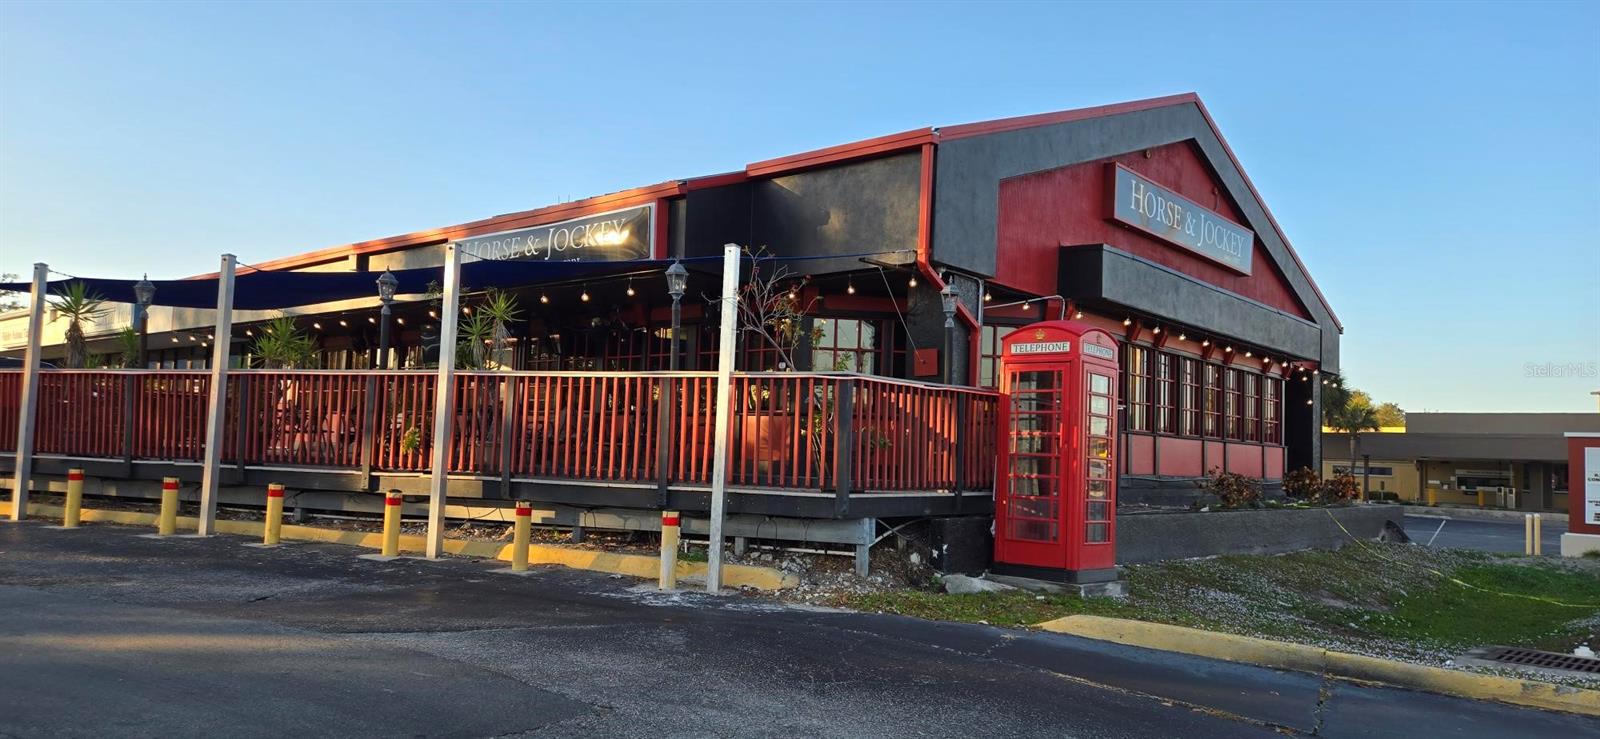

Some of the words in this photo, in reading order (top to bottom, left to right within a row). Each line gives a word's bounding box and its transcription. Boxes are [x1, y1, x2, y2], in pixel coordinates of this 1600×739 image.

[465, 236, 521, 261] HORSE
[524, 235, 540, 256] &
[545, 218, 627, 260] JOCKEY
[1130, 179, 1182, 229] HORSE
[1185, 211, 1196, 237] &
[1197, 213, 1245, 257] JOCKEY
[1013, 342, 1067, 352] TELEPHONE
